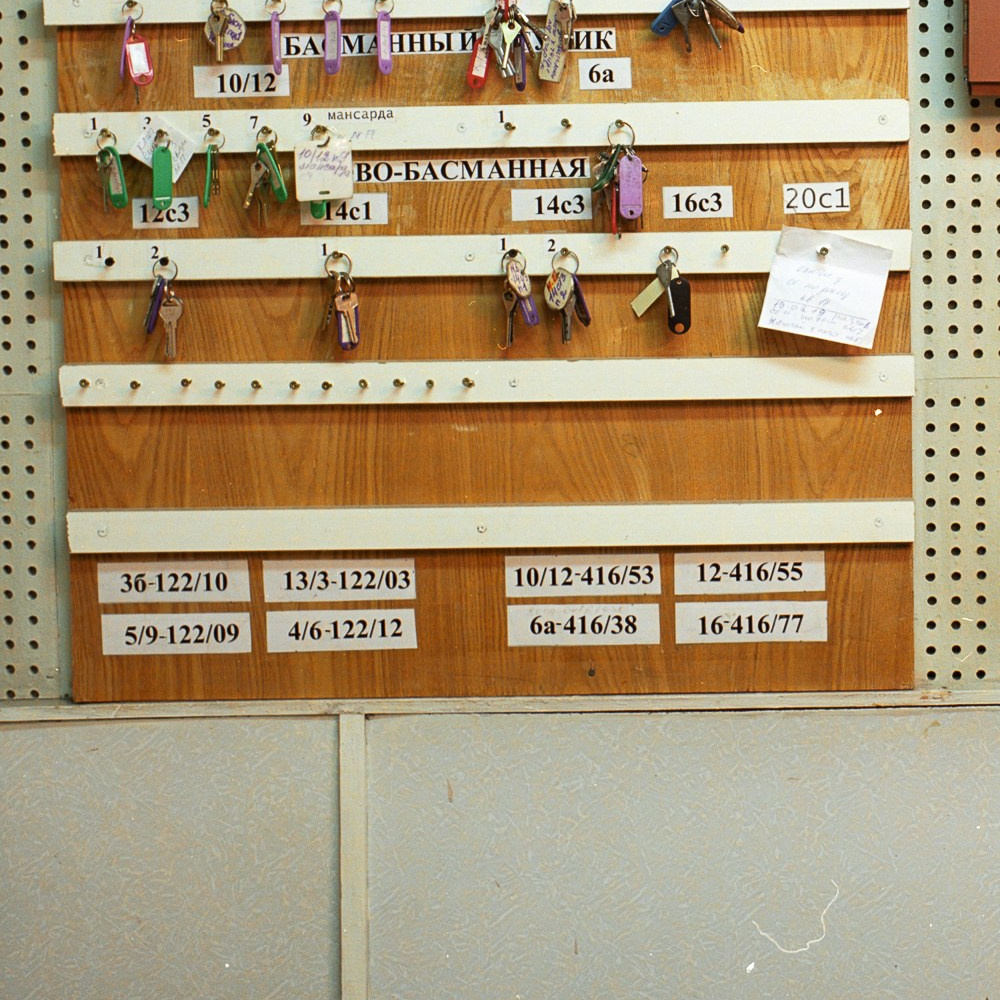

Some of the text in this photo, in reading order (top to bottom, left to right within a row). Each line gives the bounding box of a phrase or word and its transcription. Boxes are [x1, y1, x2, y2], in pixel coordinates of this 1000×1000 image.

[216, 73, 276, 94] 10/12
[589, 64, 615, 84] 6а
[90, 117, 96, 131] 1
[202, 115, 210, 128] 5
[250, 116, 258, 130] 7
[303, 113, 312, 126] 9
[498, 111, 505, 124] 1
[328, 109, 393, 121] мансарда
[356, 160, 587, 185] ВО-БАСМАННАЯ
[535, 194, 585, 215] 14с3
[672, 192, 722, 212] 16с3
[785, 187, 850, 213] 20с1
[140, 204, 190, 223] 12с3
[324, 201, 372, 221] 14с1
[96, 238, 556, 259] 1 2 1 1 2
[120, 572, 228, 593] 3б-122/10
[283, 570, 411, 591] 13/3-122/03
[514, 565, 654, 587] 10/12-416/53
[697, 562, 803, 582] 12-416/55
[124, 623, 240, 645] 5/9-122/09
[288, 618, 402, 641] 4/6-122/12
[530, 614, 637, 635] 6а-416/38
[698, 614, 804, 635] 16-416/77
